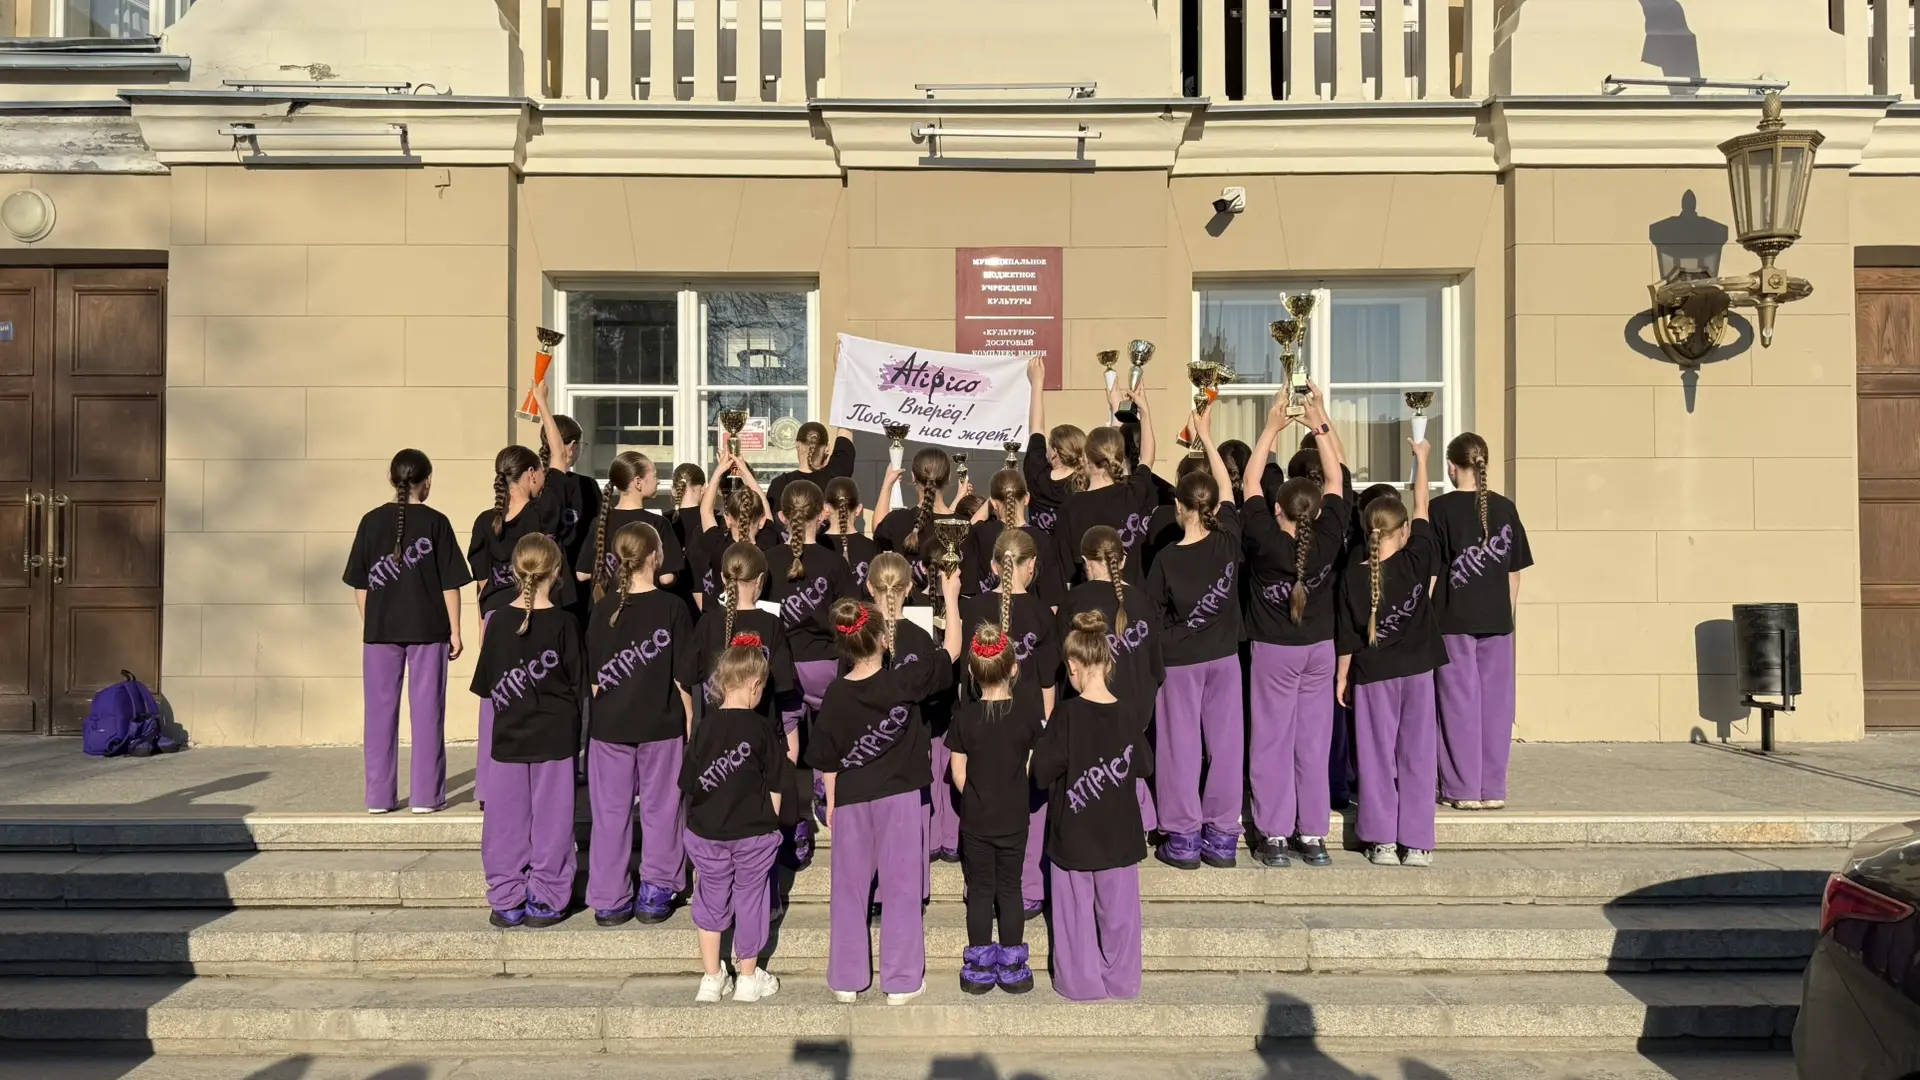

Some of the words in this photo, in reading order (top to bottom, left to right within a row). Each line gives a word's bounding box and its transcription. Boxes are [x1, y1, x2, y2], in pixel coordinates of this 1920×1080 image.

[972, 258, 1047, 266] МУНЦИПАЛЬНОЕ
[985, 338, 1034, 347] ДОСУГОВЫЙ
[890, 351, 981, 404] Atipico
[898, 396, 975, 424] Вперёд!
[918, 425, 952, 439] нас
